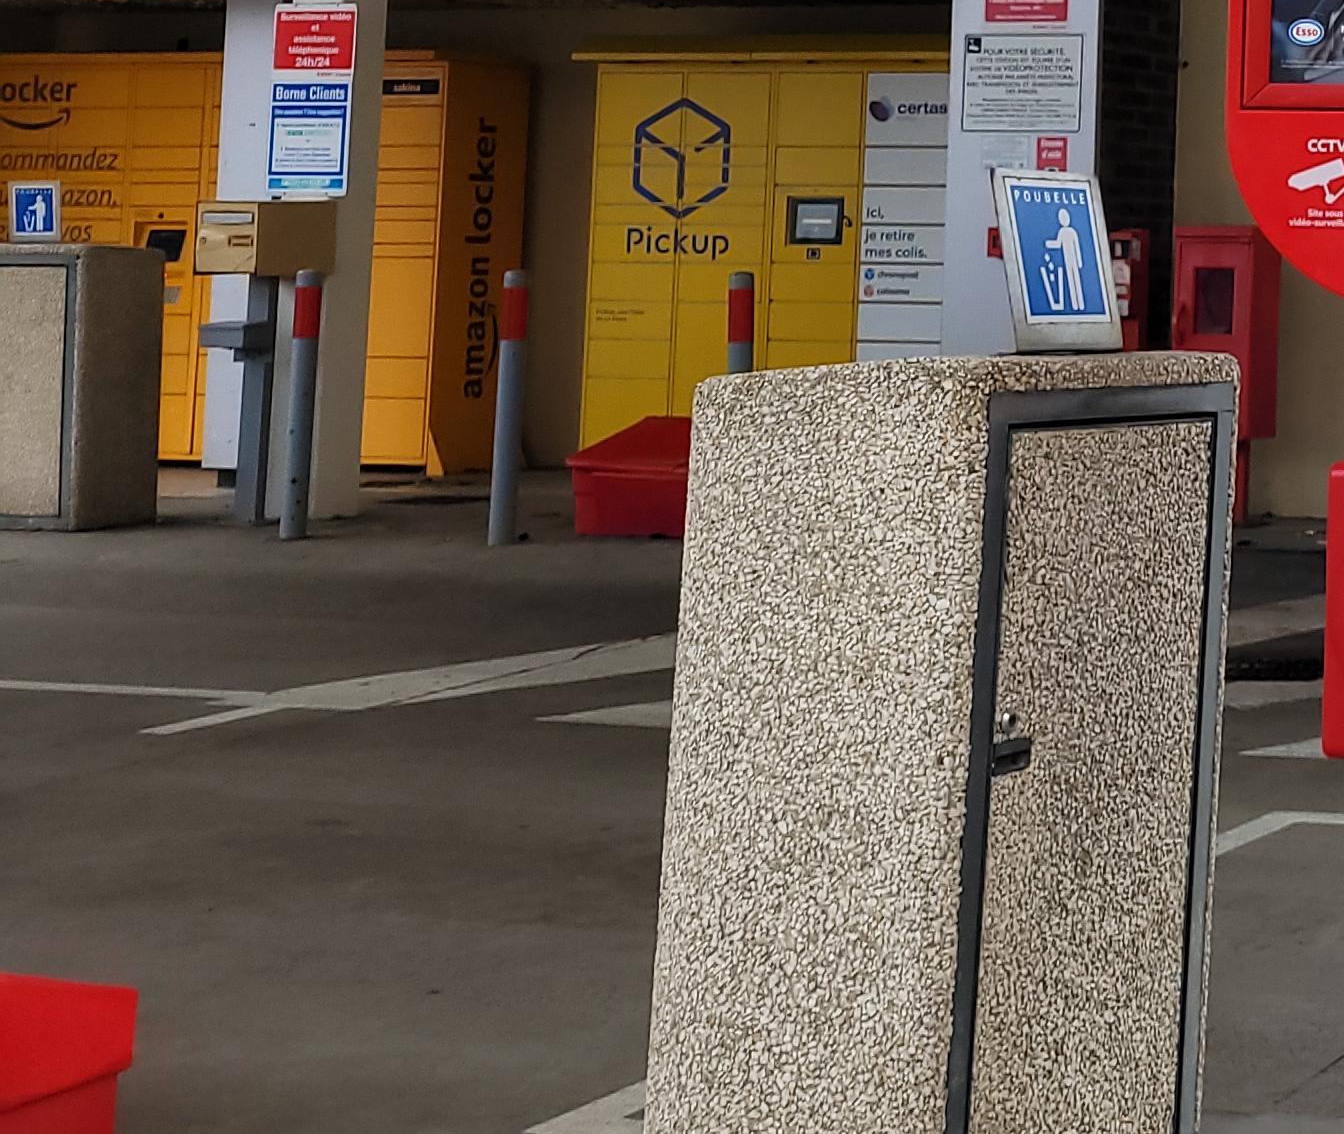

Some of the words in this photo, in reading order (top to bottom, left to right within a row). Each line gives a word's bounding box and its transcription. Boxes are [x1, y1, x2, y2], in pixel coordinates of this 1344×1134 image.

[1, 74, 77, 103] ocker
[275, 86, 307, 100] Borne
[309, 85, 346, 101] Clients
[897, 101, 948, 115] certas
[1, 146, 119, 171] ommandez
[464, 117, 498, 245] locker
[1013, 188, 1086, 205] POUBELLE
[866, 206, 884, 220] Ici,
[1307, 208, 1326, 218] Site
[1327, 209, 1344, 218] sous
[626, 227, 730, 261] Pickup
[864, 229, 877, 244] je
[880, 229, 915, 242] retire
[864, 247, 892, 258] mes
[895, 246, 927, 258] colis.
[464, 256, 491, 399] amazon
